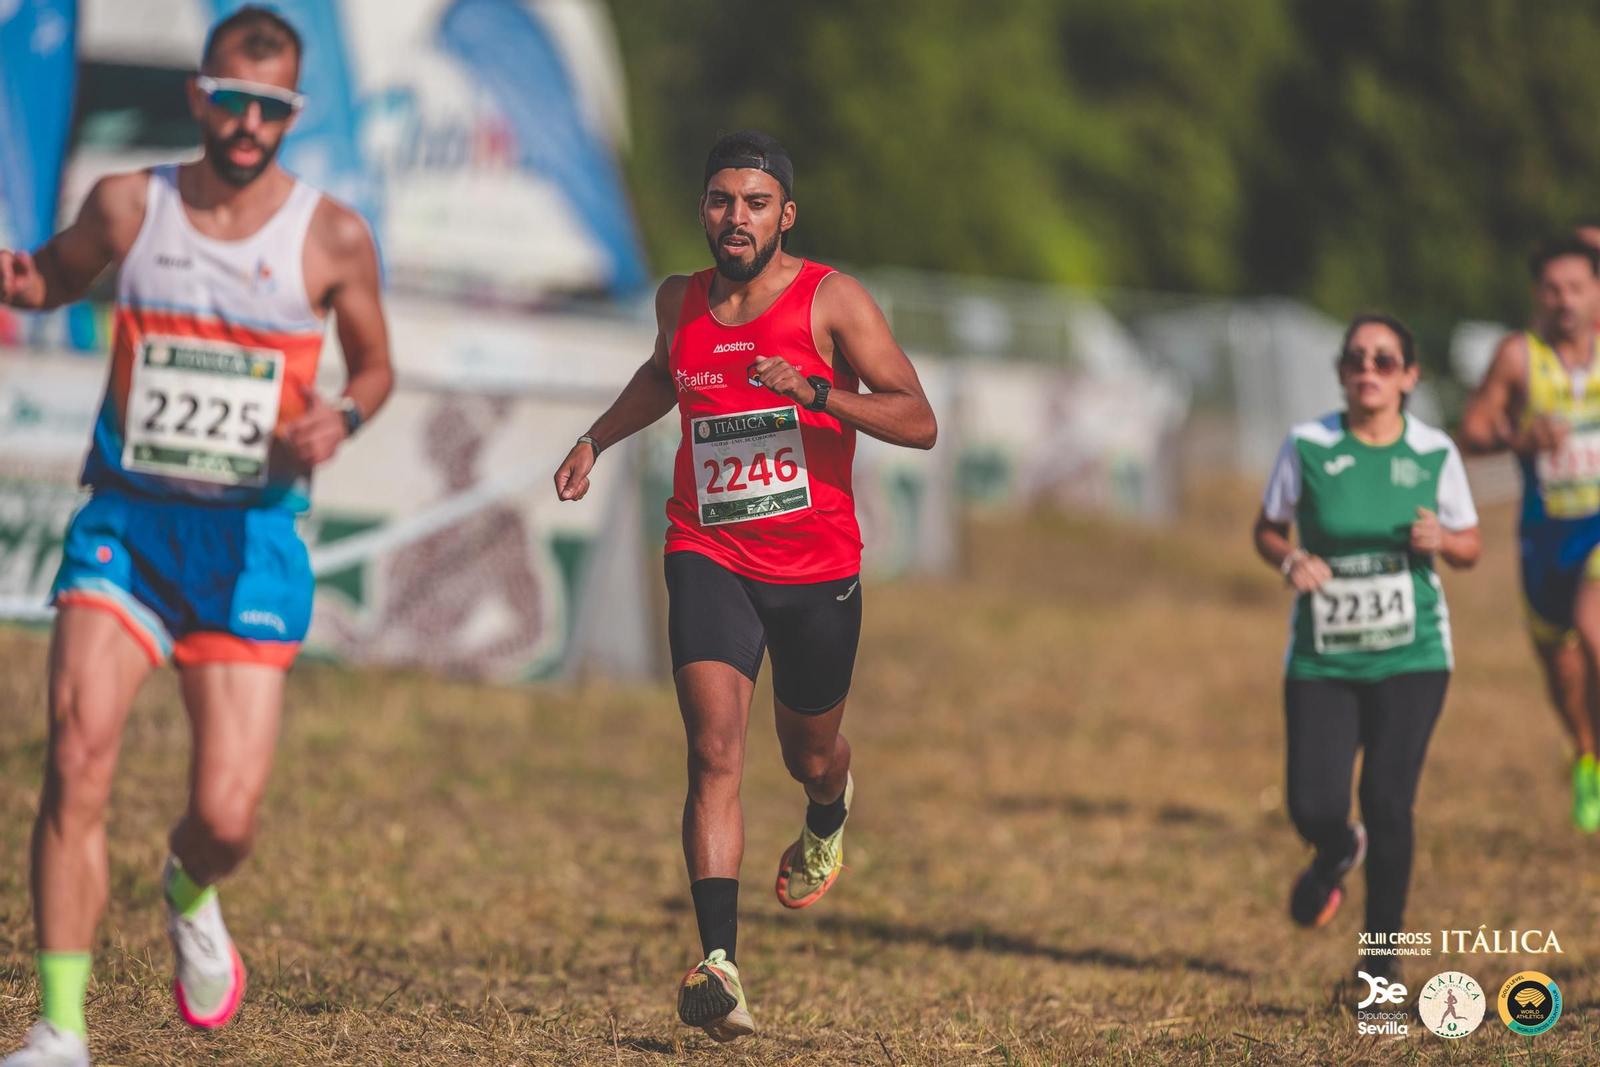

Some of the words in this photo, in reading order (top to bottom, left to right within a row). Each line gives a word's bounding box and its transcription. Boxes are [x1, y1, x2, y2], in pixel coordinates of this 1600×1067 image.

[684, 371, 724, 387] califas
[144, 390, 262, 446] 2225
[714, 416, 767, 434] ITÁLICA
[703, 446, 798, 495] 2246
[1327, 589, 1405, 624] 2234
